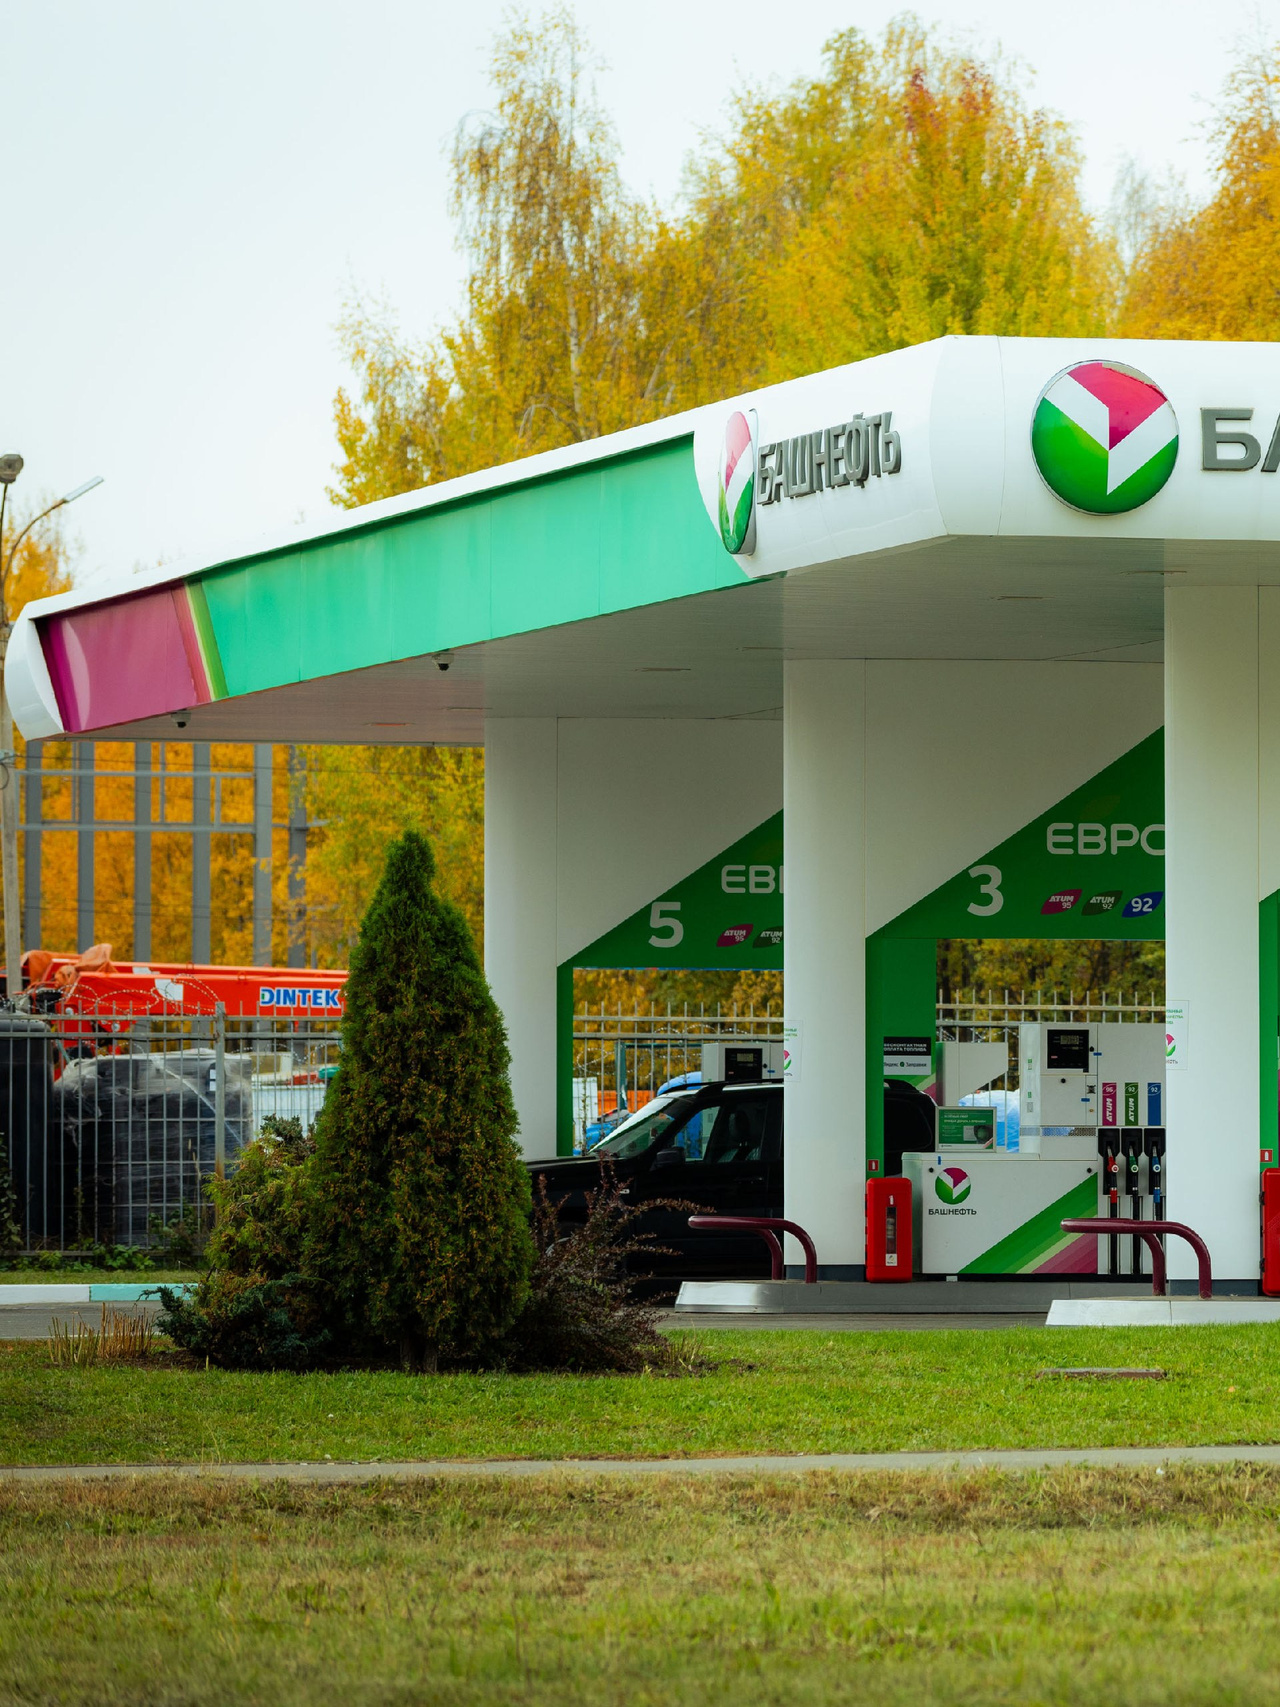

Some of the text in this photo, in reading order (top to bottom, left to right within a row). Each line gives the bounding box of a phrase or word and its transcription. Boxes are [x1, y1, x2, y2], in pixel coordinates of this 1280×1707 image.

[757, 411, 902, 506] БАШНЕФТЬ
[721, 864, 785, 894] ЕВ
[966, 864, 1004, 917] 3
[1049, 895, 1075, 904] ATUM
[1061, 901, 1072, 909] 95
[1090, 896, 1116, 904] ATUM
[1102, 902, 1113, 910] 92
[1131, 897, 1153, 912] 92
[648, 901, 685, 948] 5
[260, 986, 341, 1008] DINTEK
[928, 1208, 977, 1216] БАШНЕФТЬ
